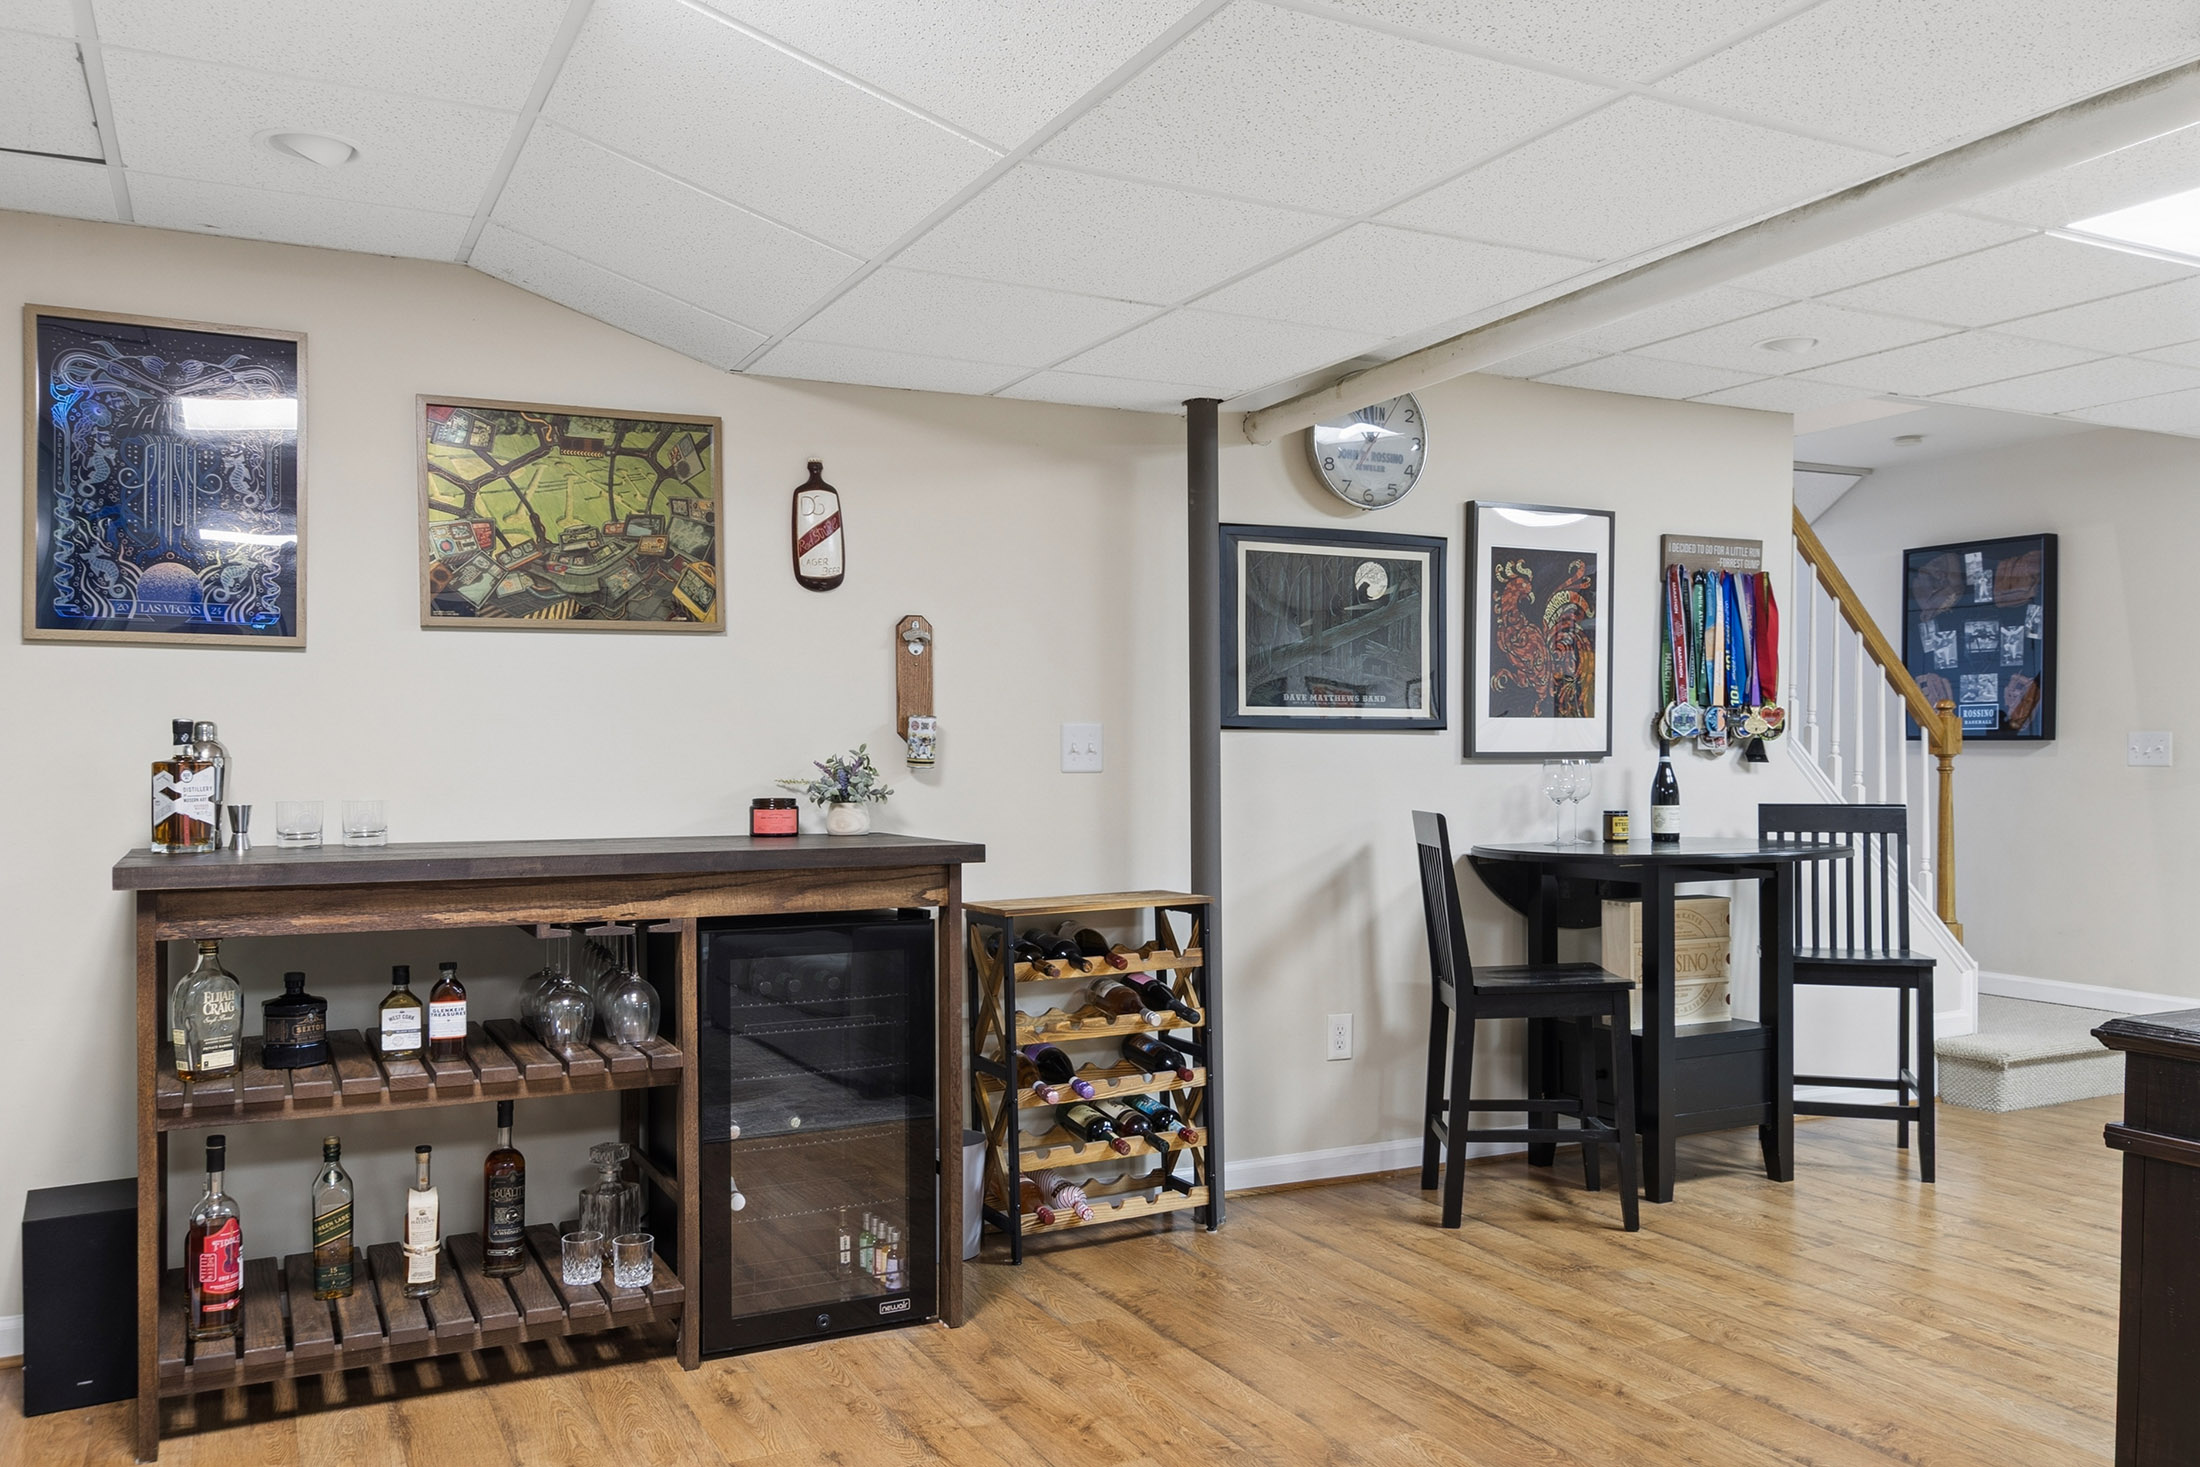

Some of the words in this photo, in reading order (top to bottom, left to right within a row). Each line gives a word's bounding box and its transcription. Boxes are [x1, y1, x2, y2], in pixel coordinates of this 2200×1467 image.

[1404, 409, 1415, 423] 2
[1324, 456, 1335, 471] 8
[1404, 464, 1415, 478] 4
[1342, 479, 1352, 493] 7
[1387, 483, 1398, 496] 5
[1363, 489, 1374, 503] 6
[1671, 542, 1696, 553] DECIDED
[1697, 544, 1704, 554] TO
[1705, 544, 1713, 555] GO
[1713, 545, 1725, 555] FOR
[1725, 546, 1730, 556] A
[1730, 546, 1748, 557] LITTLE
[1744, 559, 1761, 569] GUMP
[140, 603, 161, 613] LAS
[163, 604, 201, 615] VEGAS
[1283, 693, 1308, 701] DAVE
[1309, 694, 1360, 702] MATTHEWS
[1963, 709, 1994, 718] ROSSINO
[1676, 953, 1709, 973] SINO
[203, 990, 236, 1004] ELIJAH
[202, 1001, 236, 1015] CRAIG
[881, 1300, 909, 1312] newair
